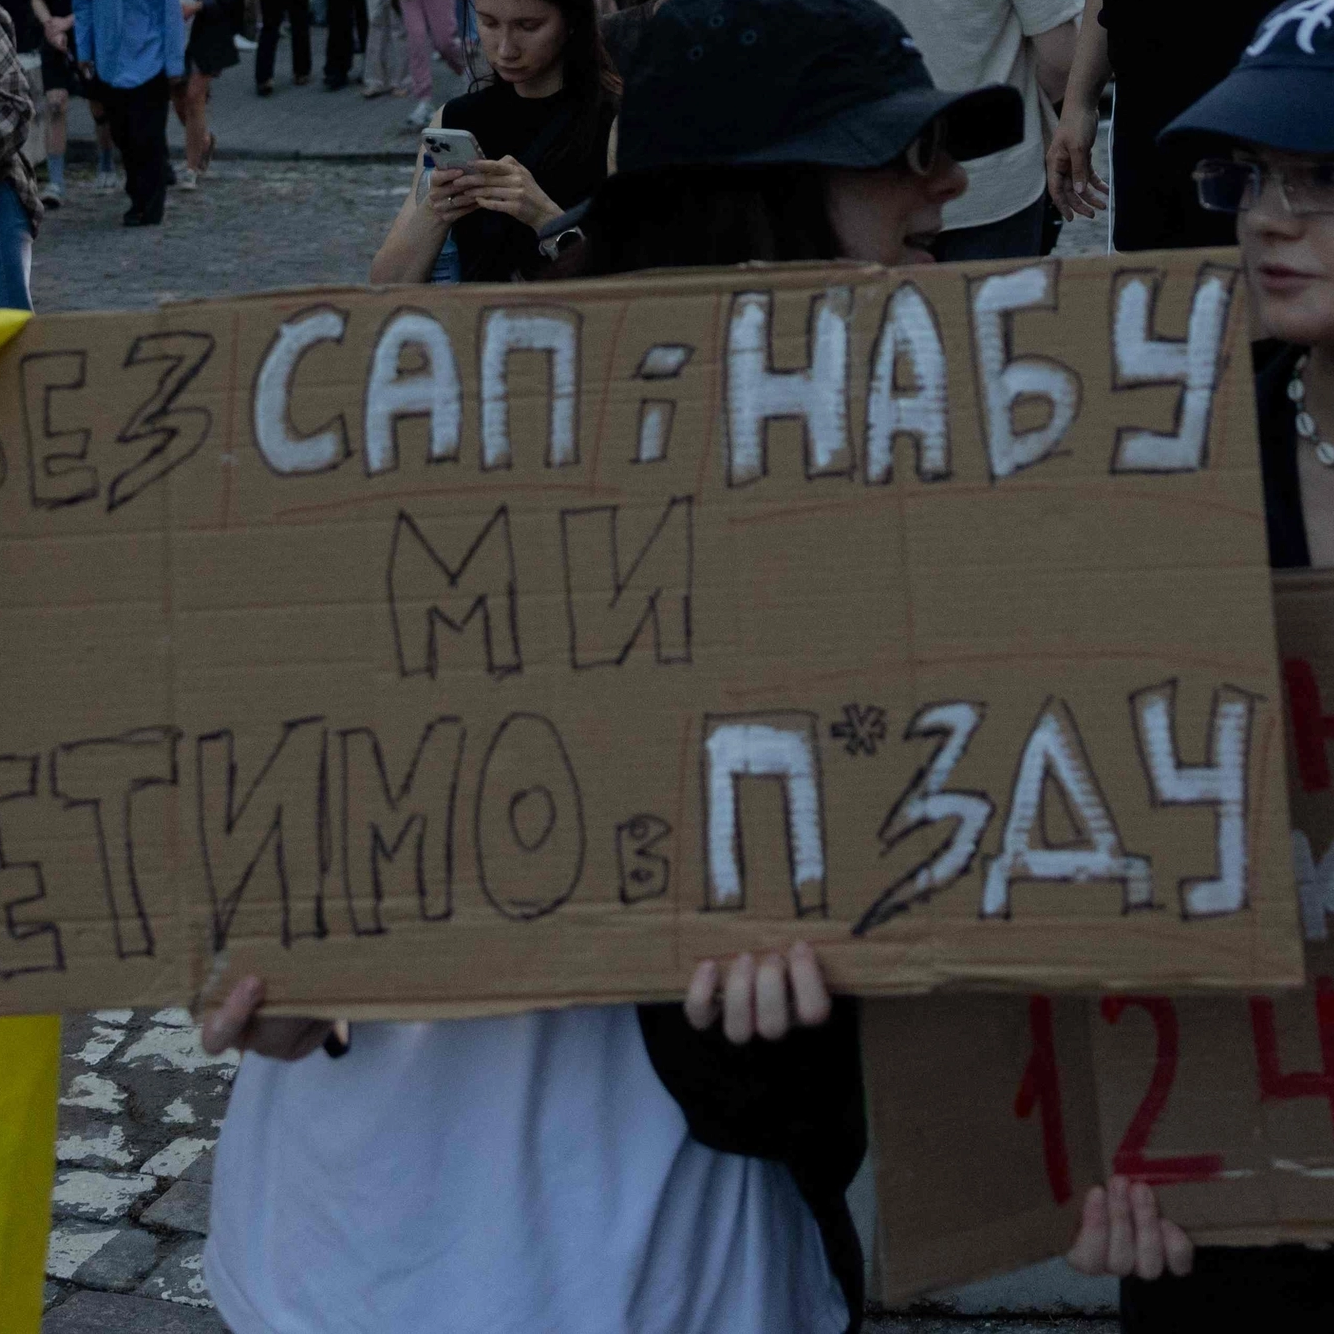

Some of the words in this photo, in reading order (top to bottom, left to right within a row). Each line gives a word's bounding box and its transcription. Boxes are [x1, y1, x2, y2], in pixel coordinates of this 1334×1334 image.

[251, 302, 584, 478] САП
[722, 261, 1249, 488] НАБУ
[387, 495, 695, 681] МИ
